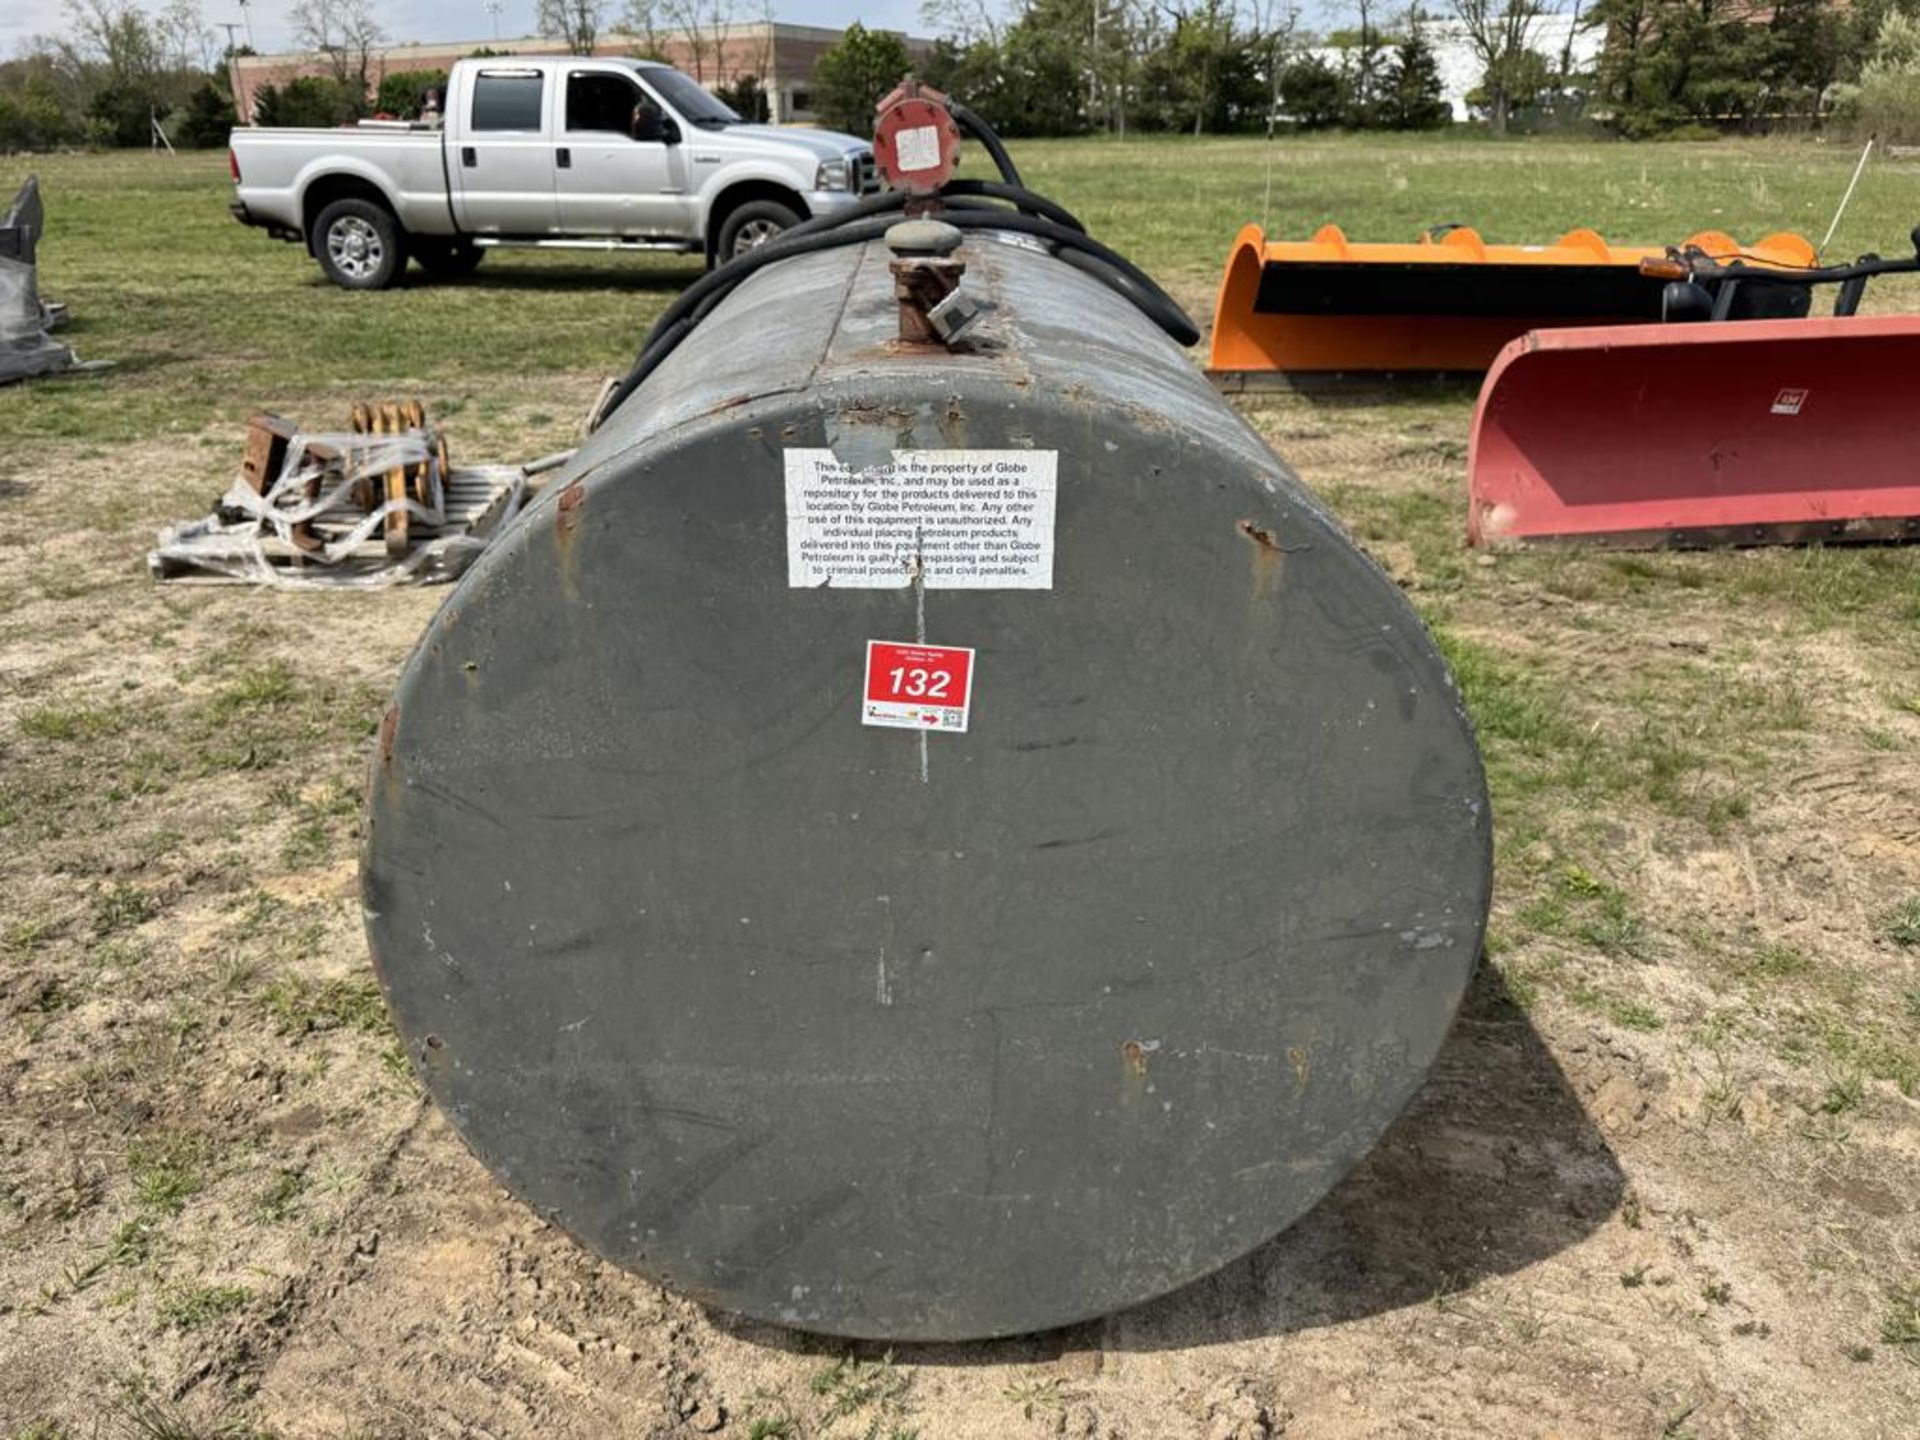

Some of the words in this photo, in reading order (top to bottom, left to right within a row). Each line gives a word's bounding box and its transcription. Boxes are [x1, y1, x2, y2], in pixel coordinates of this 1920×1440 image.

[815, 461, 836, 472] This
[898, 463, 908, 472] is
[911, 463, 928, 473] the
[931, 463, 978, 475] property
[981, 463, 992, 473] of
[996, 462, 1028, 473] Globe
[904, 476, 924, 486] and
[926, 477, 948, 487] may
[952, 476, 965, 486] be
[968, 476, 995, 486] used
[997, 478, 1010, 486] as
[1013, 478, 1019, 486] a
[804, 489, 859, 499] repository
[862, 489, 877, 498] for
[882, 489, 899, 499] the
[902, 489, 949, 500] products
[952, 490, 1001, 499] delivered
[1003, 490, 1014, 499] to
[1017, 490, 1037, 499] this
[806, 502, 850, 511] location
[852, 502, 864, 513] by
[868, 502, 899, 512] Globe
[982, 502, 1002, 514] Any
[1006, 503, 1034, 512] other
[808, 516, 827, 524] use
[830, 515, 841, 524] of
[845, 515, 864, 524] this
[867, 515, 922, 527] equipment
[925, 516, 934, 525] is
[1011, 516, 1033, 527] Any
[823, 528, 873, 537] individual
[875, 528, 912, 539] placing
[971, 529, 1018, 539] products
[800, 540, 848, 550] delivered
[851, 541, 870, 550] into
[873, 541, 892, 550] this
[953, 541, 980, 550] other
[984, 541, 1008, 550] than
[1010, 540, 1041, 550] Globe
[801, 552, 854, 562] Petroleum
[857, 553, 865, 562] is
[868, 553, 896, 564] guilty
[914, 554, 976, 565] espassing
[979, 554, 998, 563] and
[1001, 554, 1039, 565] subject
[812, 565, 824, 574] to
[826, 565, 867, 575] criminal
[869, 566, 931, 576] prosecun
[934, 566, 953, 575] and
[956, 566, 978, 575] civil
[980, 566, 1029, 577] penalties.
[889, 667, 952, 698] 132
